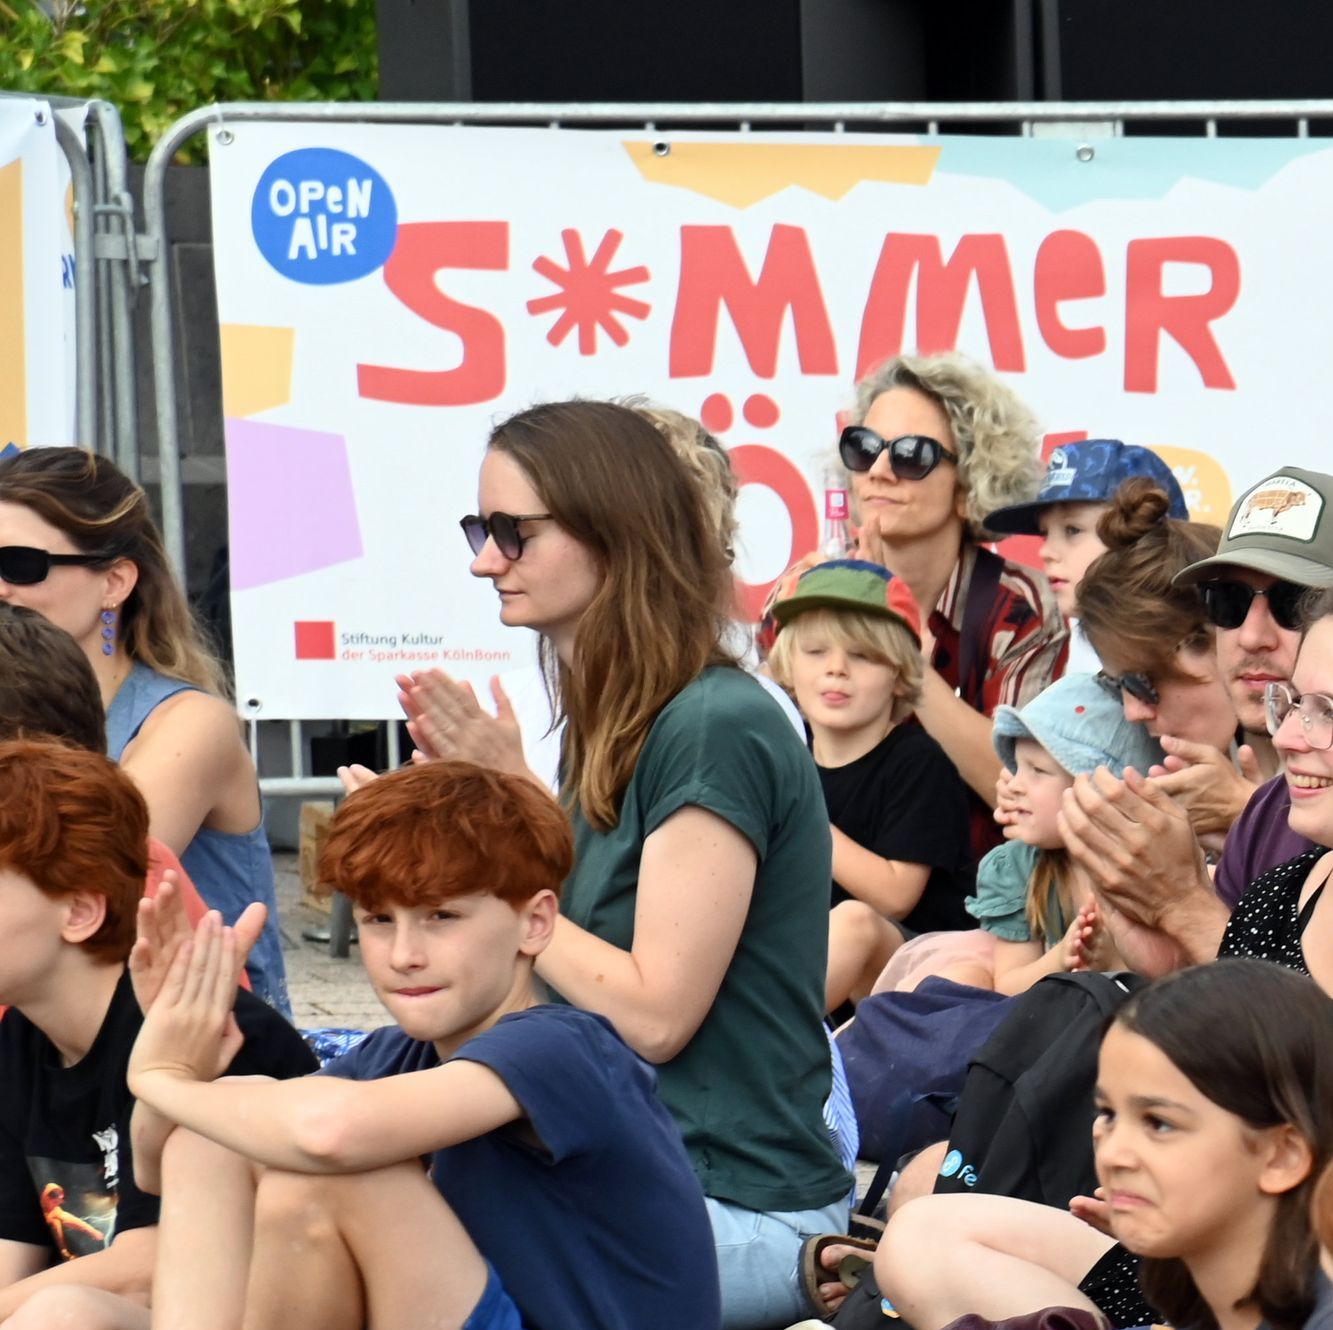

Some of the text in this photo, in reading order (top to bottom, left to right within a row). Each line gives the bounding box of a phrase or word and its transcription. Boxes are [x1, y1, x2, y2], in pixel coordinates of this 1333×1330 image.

[287, 213, 357, 260] AIR
[341, 633, 445, 648] Stiftung Kultur
[342, 648, 511, 663] der Sparkasse KölnBonn
